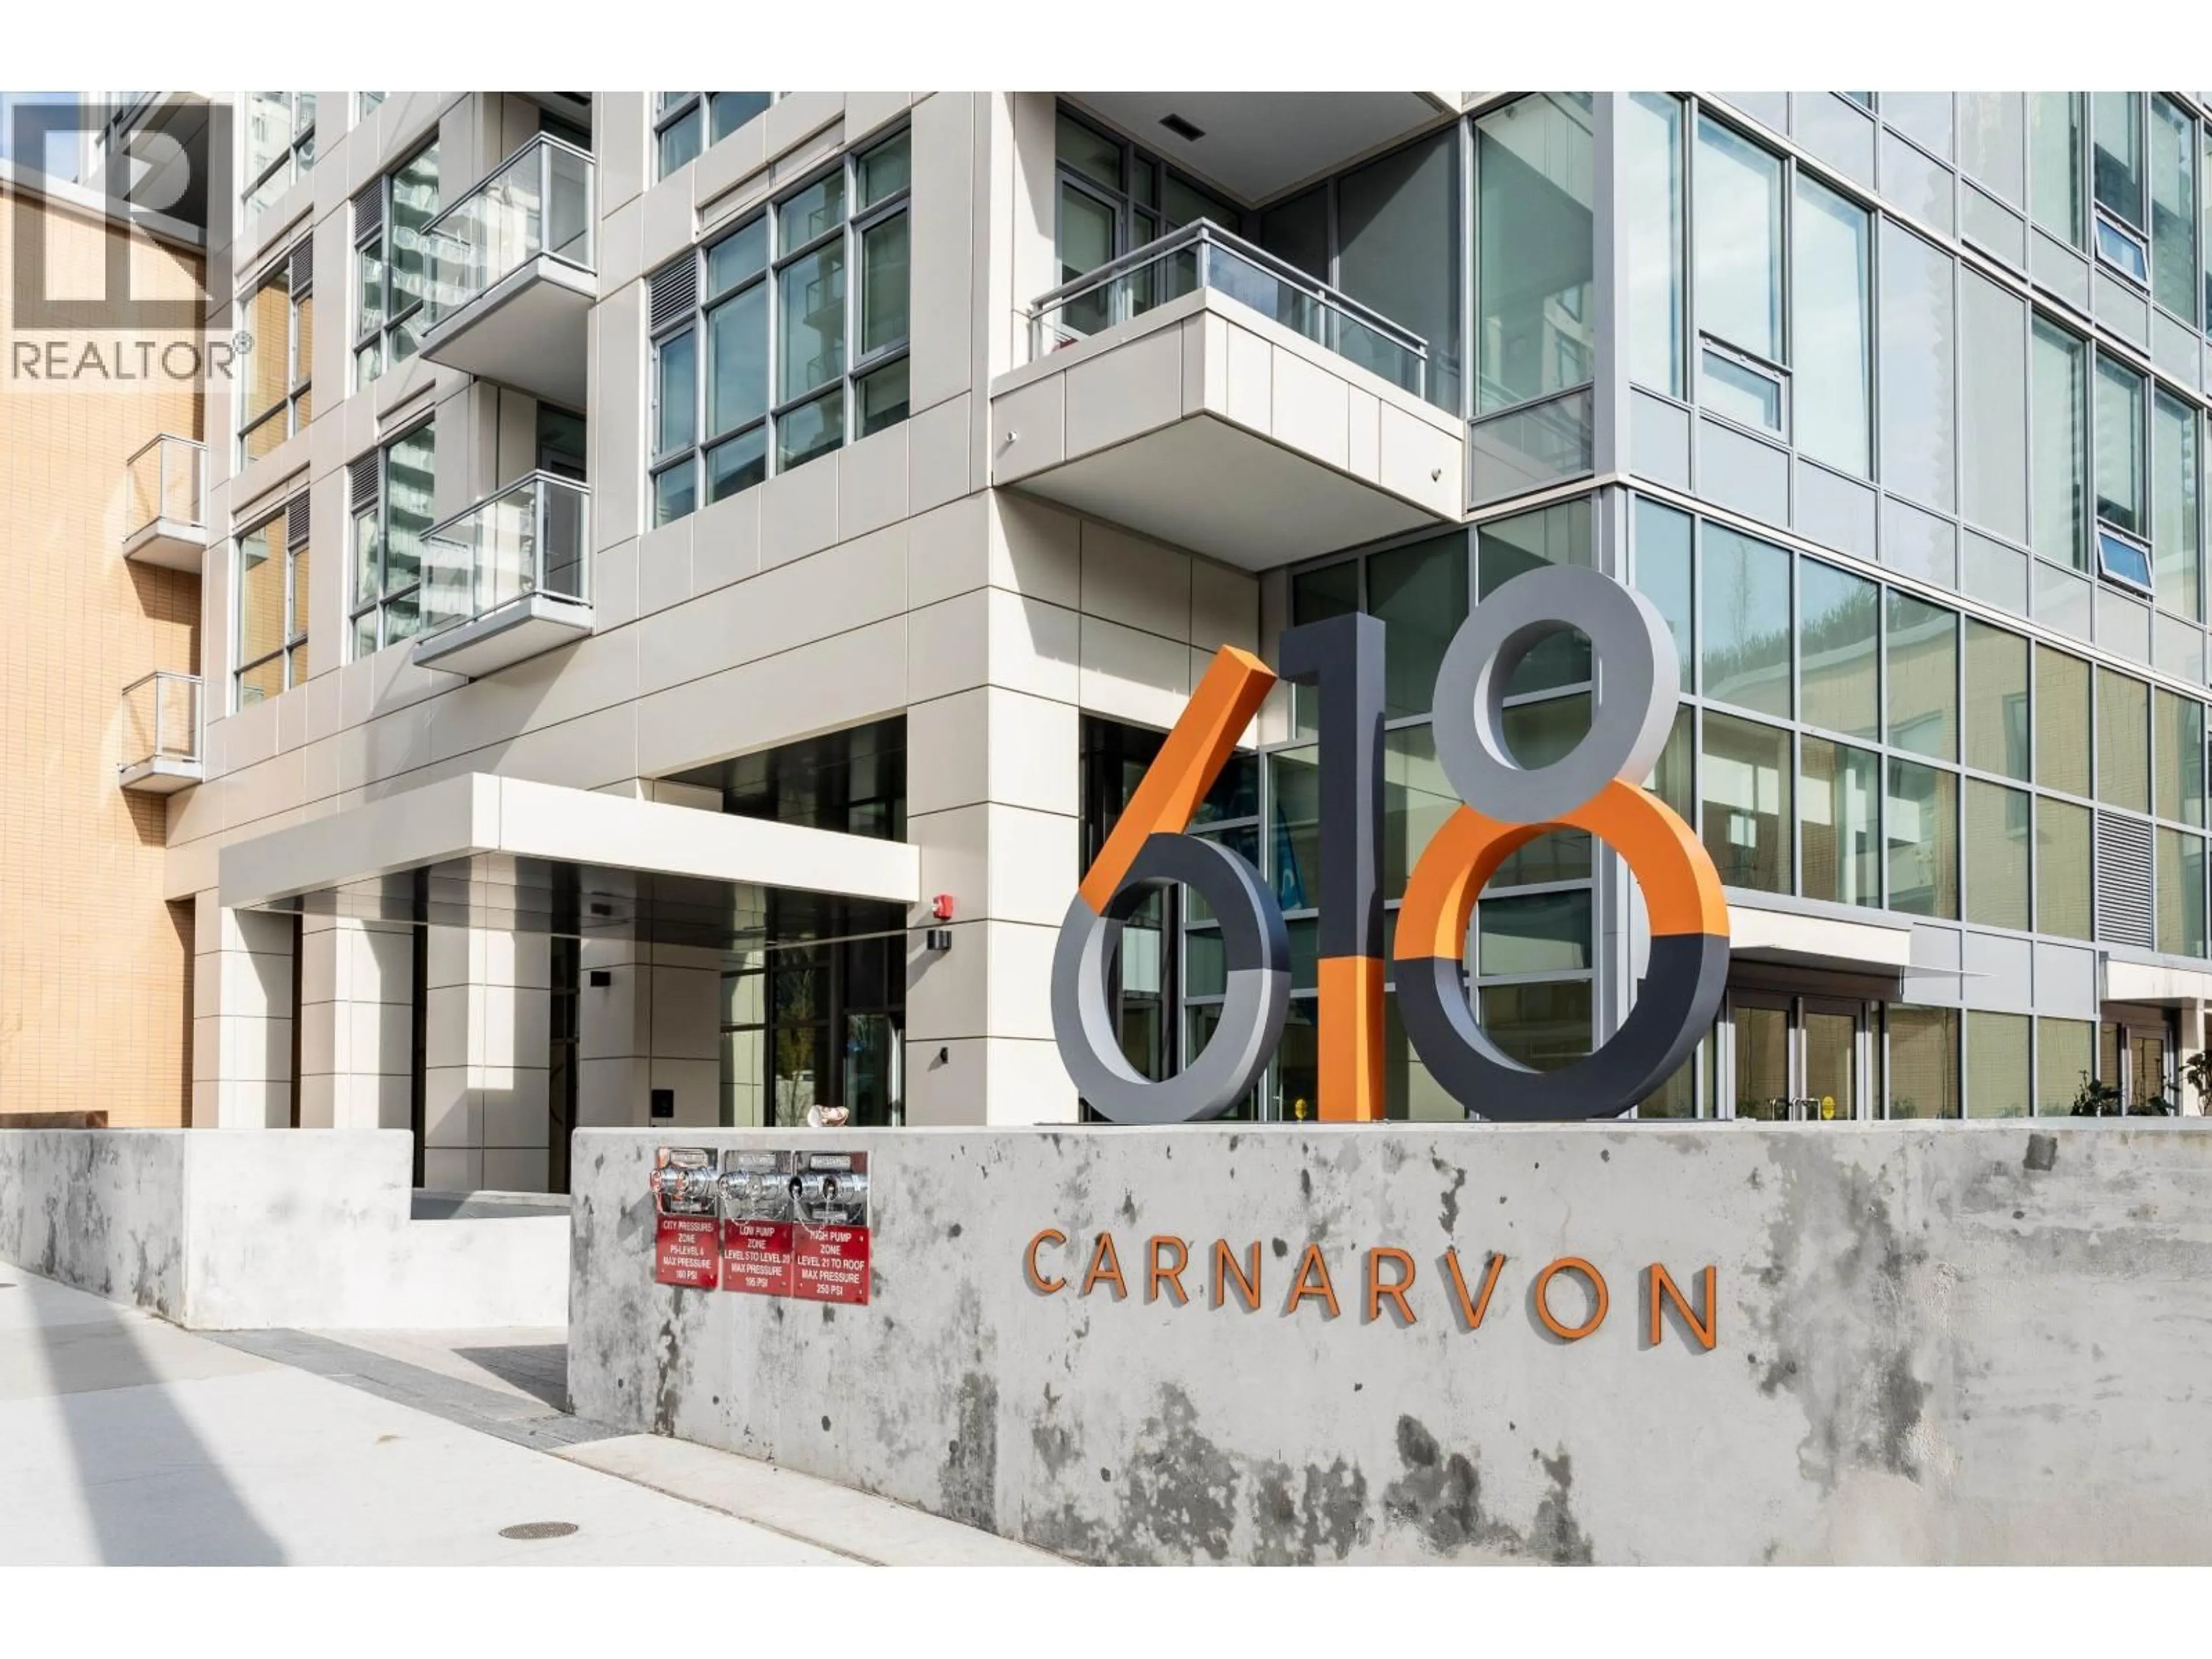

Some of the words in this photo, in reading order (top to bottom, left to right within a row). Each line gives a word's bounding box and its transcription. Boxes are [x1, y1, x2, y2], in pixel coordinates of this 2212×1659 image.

[1051, 565, 1730, 1122] 618
[663, 1220, 676, 1229] CITY
[678, 1221, 714, 1232] PRESSURE
[740, 1225, 754, 1236] LOW
[756, 1226, 775, 1237] PUMP
[678, 1233, 695, 1243] ZONE
[810, 1230, 828, 1241] HIGH
[830, 1232, 851, 1242] PUMP
[748, 1238, 766, 1249] ZONE
[820, 1244, 840, 1255] ZONE
[664, 1256, 677, 1266] MAX
[677, 1257, 711, 1268] PRESSURE
[724, 1249, 744, 1260] LEVEL
[750, 1251, 759, 1262] TO
[760, 1252, 781, 1263] LEVEL
[797, 1255, 820, 1267] LEVEL
[821, 1257, 830, 1267] 21
[831, 1258, 841, 1268] TO
[843, 1259, 865, 1271] ROOF
[687, 1271, 698, 1279] PSI
[731, 1262, 745, 1272] MAX
[747, 1263, 782, 1277] PRESSURE
[802, 1268, 817, 1279] MAX
[820, 1270, 859, 1284] PRESSURE
[757, 1277, 768, 1288] PSI
[1025, 1228, 1717, 1349] CARNARVON
[831, 1285, 843, 1296] PSI
